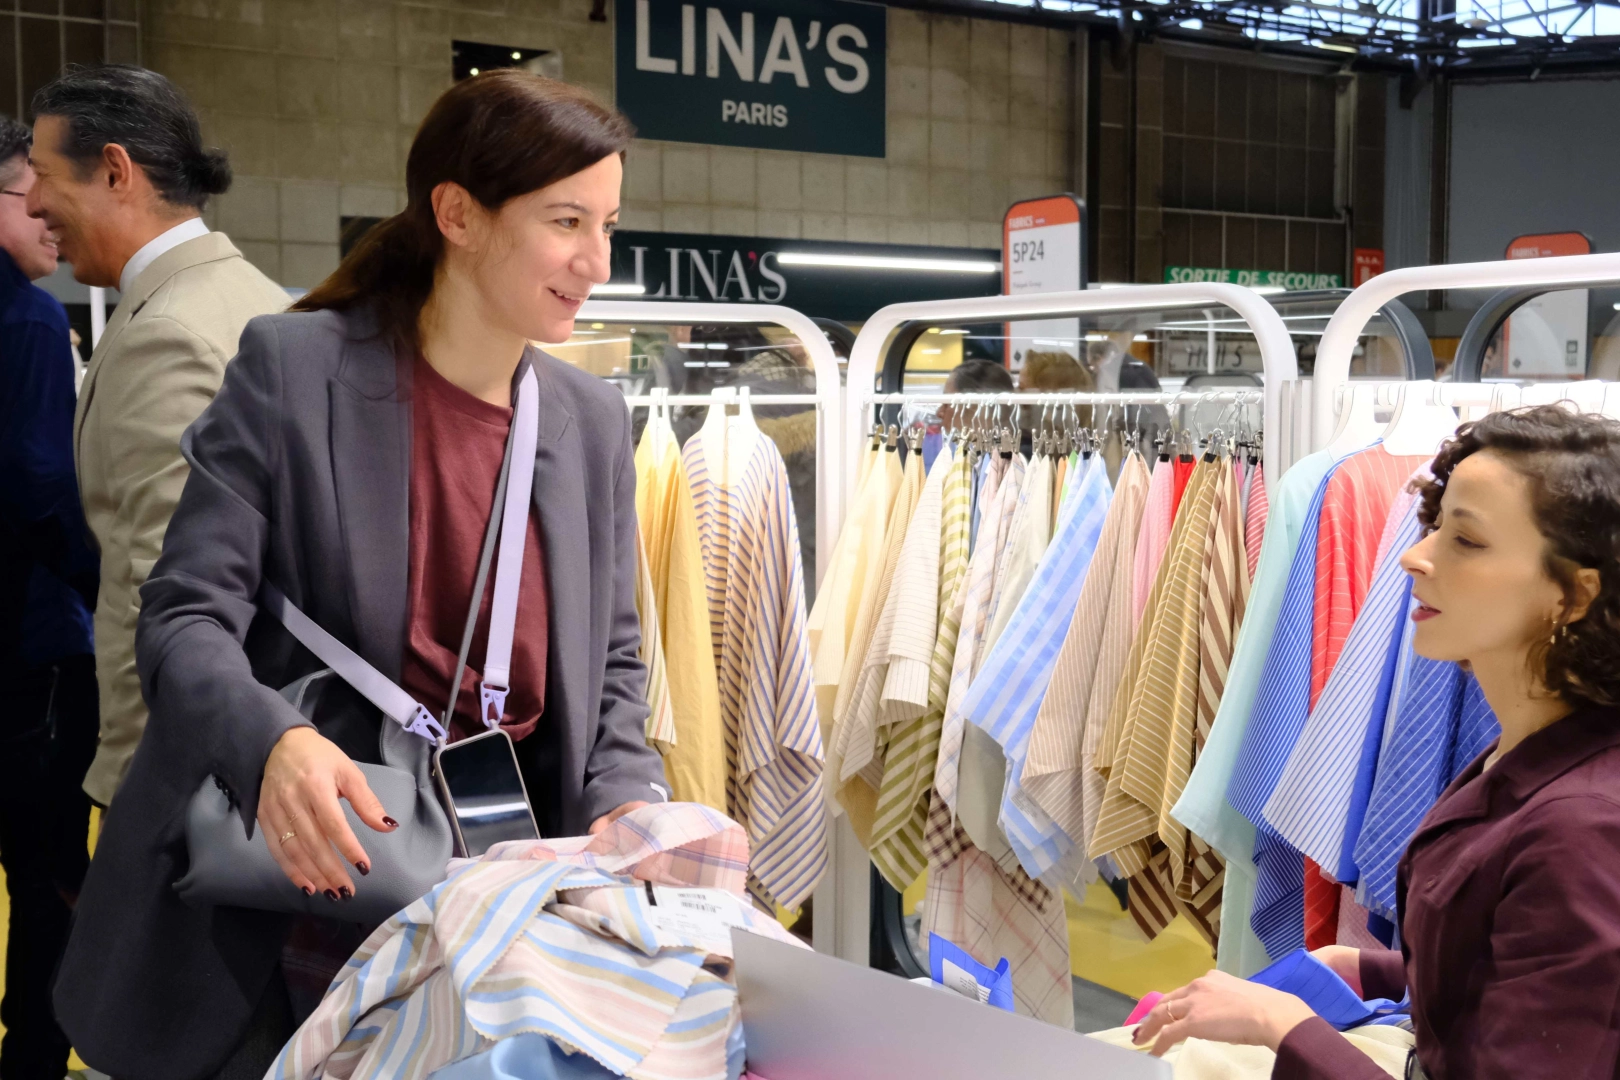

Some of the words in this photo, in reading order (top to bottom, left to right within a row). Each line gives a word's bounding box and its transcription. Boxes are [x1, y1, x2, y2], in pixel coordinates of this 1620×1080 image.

[636, 0, 870, 94] LINA'S
[722, 100, 788, 128] PARIS
[1013, 240, 1044, 263] 5P24
[629, 246, 787, 304] LINA'S
[1169, 267, 1231, 284] SORTIE
[1237, 270, 1260, 287] DE
[1267, 272, 1338, 290] SECOURS
